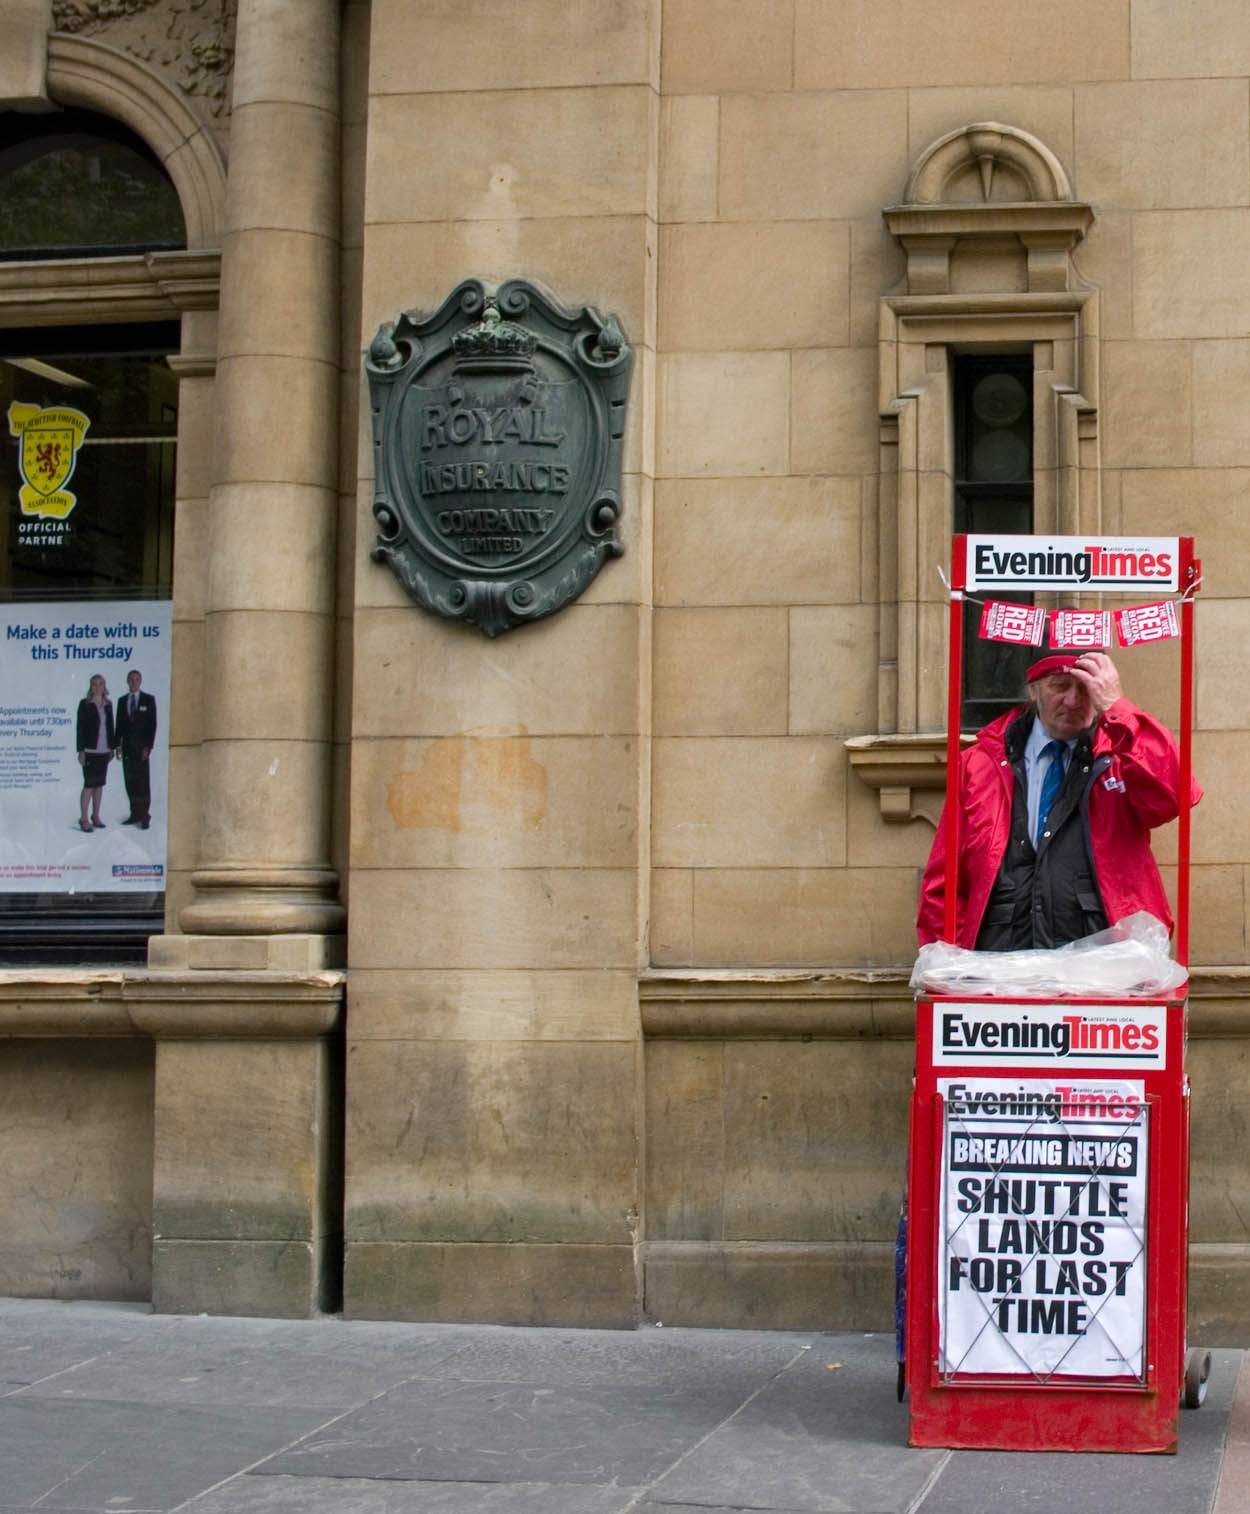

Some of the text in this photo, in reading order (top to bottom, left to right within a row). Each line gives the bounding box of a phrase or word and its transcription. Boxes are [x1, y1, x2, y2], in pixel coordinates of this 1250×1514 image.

[420, 404, 567, 450] ROYAL
[419, 459, 569, 497] INSURANCE
[19, 522, 72, 533] OFFICIAL
[438, 508, 555, 536] COMPANY
[461, 537, 524, 555] LIMITED
[6, 621, 160, 640] Make a date with us
[993, 604, 1006, 637] BOOK
[1002, 606, 1028, 641] RED
[1063, 613, 1073, 645] BOOK
[1072, 613, 1096, 646] RED
[1128, 610, 1141, 641] BOOK
[1136, 605, 1163, 641] RED
[31, 643, 134, 662] this Thursday
[29, 718, 45, 726] until
[51, 707, 67, 715] now
[20, 728, 52, 738] Thursday
[954, 1137, 1133, 1168] BREAKING NEWS
[957, 1177, 1129, 1217] SHUTTLE
[977, 1218, 1105, 1256] LANDS
[950, 1256, 1134, 1296] FOR LAST
[992, 1298, 1088, 1336] TIME
